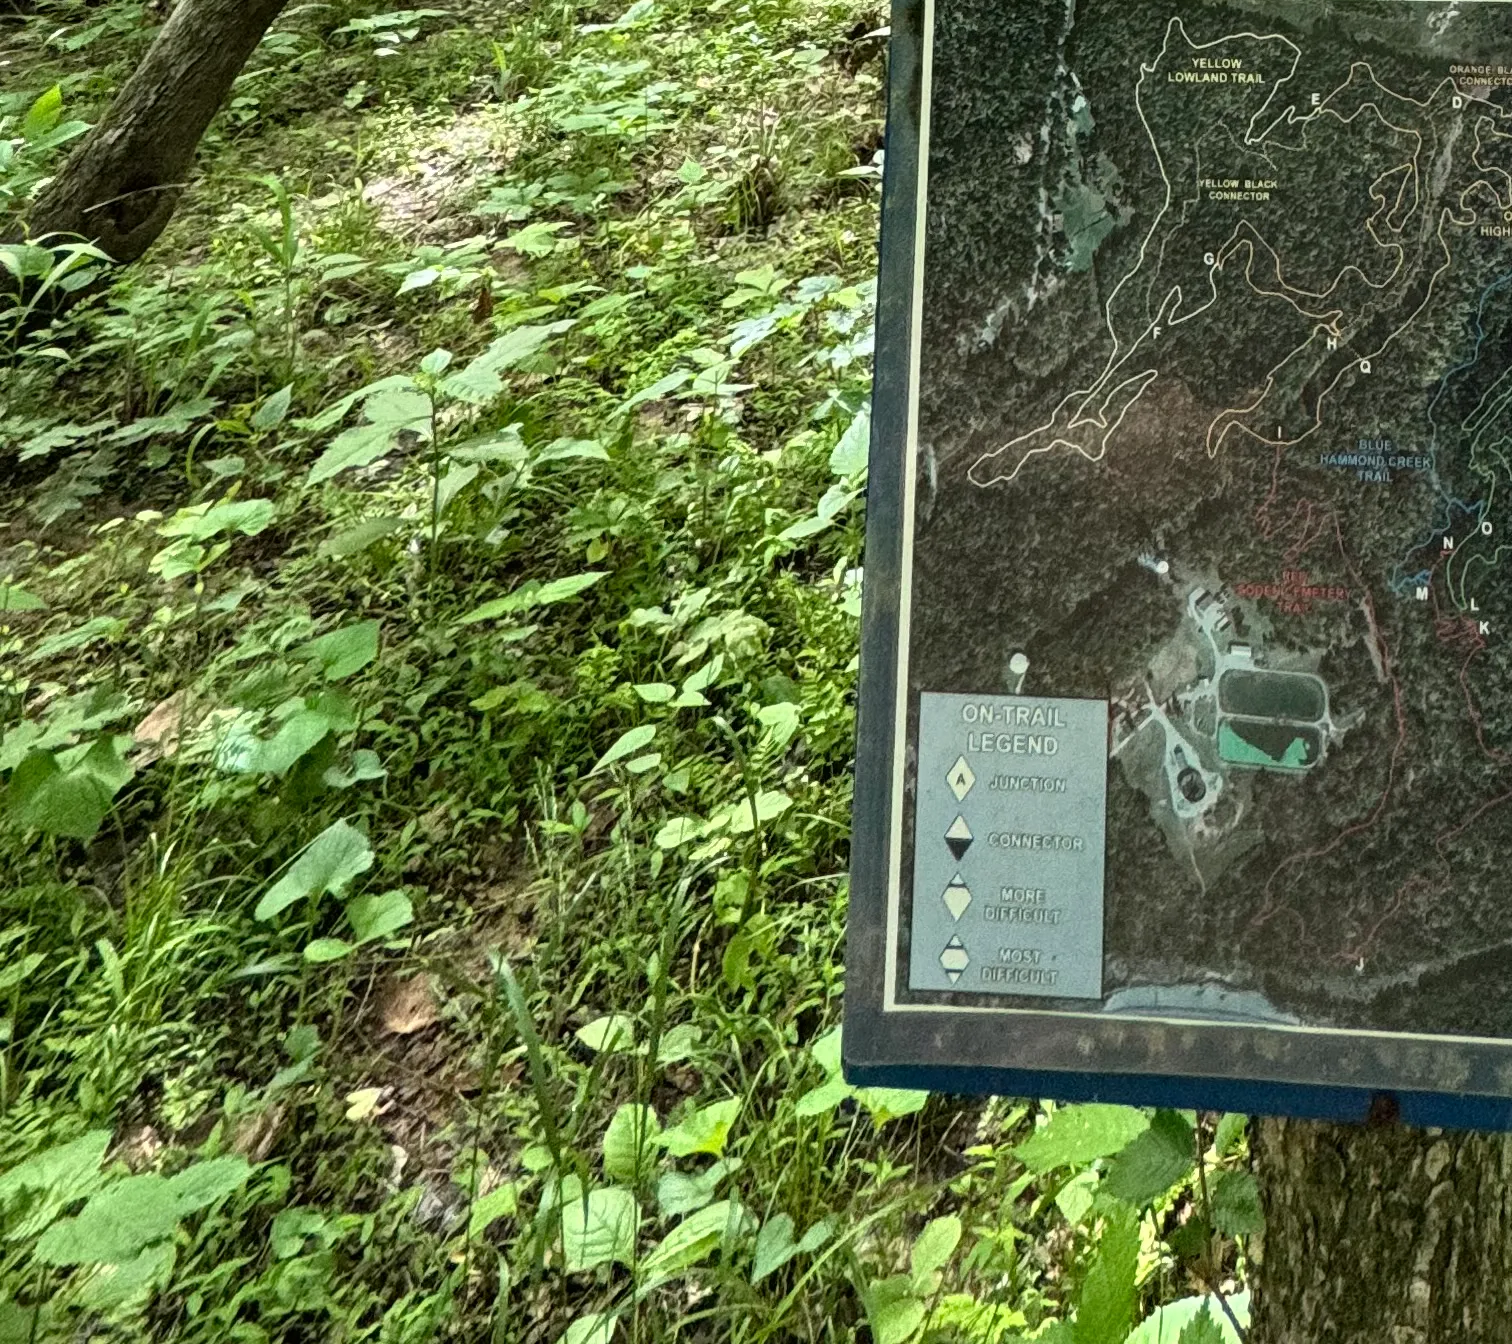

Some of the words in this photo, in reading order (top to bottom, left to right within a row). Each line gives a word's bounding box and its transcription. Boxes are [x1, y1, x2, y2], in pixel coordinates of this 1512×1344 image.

[1192, 58, 1242, 68] YELLOW
[1449, 65, 1491, 74] ORANGE
[1168, 72, 1228, 83] LOWLAND
[1231, 73, 1265, 84] TRAIL
[1311, 93, 1320, 105] E
[1452, 96, 1463, 109] D
[1199, 179, 1240, 188] YELLOW
[1244, 180, 1278, 189] BLACK
[1208, 191, 1270, 200] CONNECTOR
[1204, 253, 1214, 265] G
[1153, 327, 1161, 339] F
[1327, 338, 1337, 350] H
[1360, 361, 1371, 373] Q
[1359, 440, 1392, 451] BLUE
[1320, 454, 1385, 466] HAMMOND
[1389, 456, 1431, 468] CREEK
[1360, 471, 1393, 482] TRAIL
[1443, 537, 1453, 549] N
[1416, 587, 1428, 600] M
[1470, 598, 1479, 611] L
[1480, 621, 1490, 635] K
[962, 704, 1066, 727] ON-TRAIL
[968, 732, 1058, 755] LEGEND
[956, 773, 966, 786] A
[989, 775, 1067, 792] JUNCTION
[988, 832, 1084, 850] CONNECTOR
[1001, 886, 1046, 904] MORE
[984, 905, 1061, 924] DIFFICULT
[999, 948, 1041, 964] MOST
[982, 966, 1058, 984] DIFFICULT
